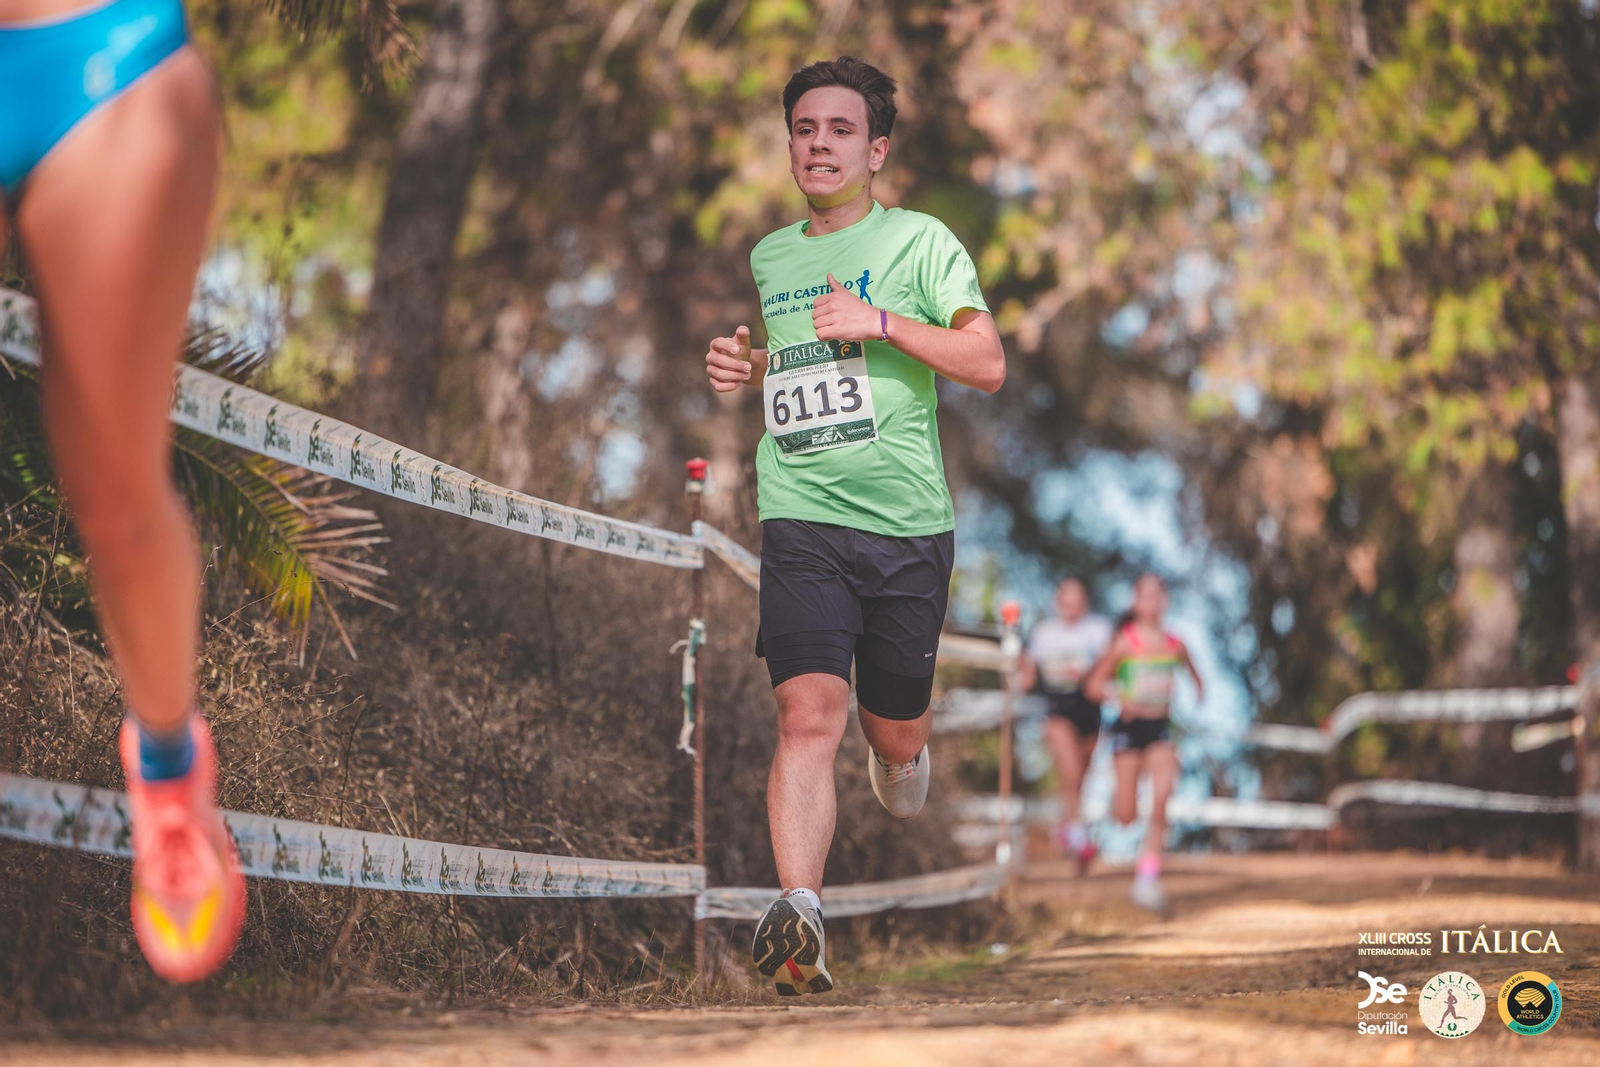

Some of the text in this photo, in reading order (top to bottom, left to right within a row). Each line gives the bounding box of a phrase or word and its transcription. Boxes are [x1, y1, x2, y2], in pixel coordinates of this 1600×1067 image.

[794, 280, 853, 299] CASTIO
[789, 305, 800, 313] de
[784, 343, 833, 363] ITÁLICA
[773, 377, 863, 426] 6113
